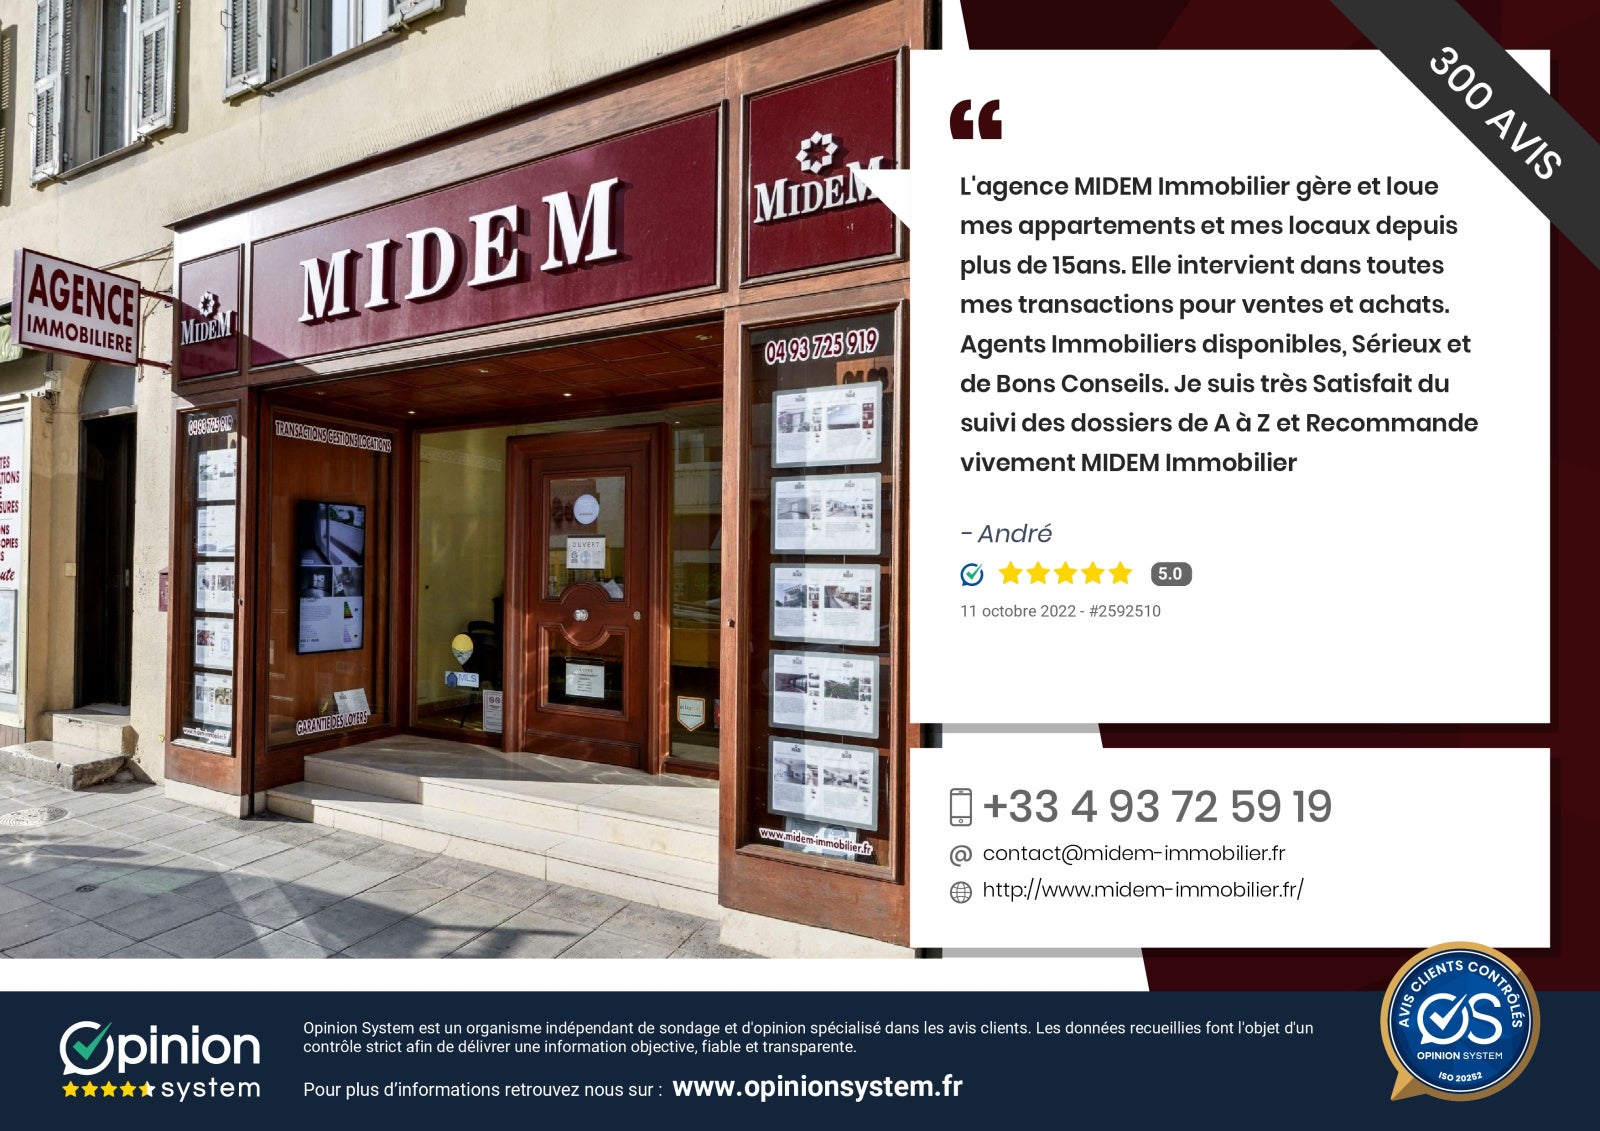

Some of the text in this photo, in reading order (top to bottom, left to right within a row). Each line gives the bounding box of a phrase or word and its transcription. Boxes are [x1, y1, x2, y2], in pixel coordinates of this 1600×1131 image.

[298, 177, 619, 322] MIDEM
[28, 263, 134, 327] AGENCE
[27, 314, 132, 353] IMMOBILIERE
[181, 310, 232, 346] MIDEM
[765, 327, 879, 365] 04 93 725 919
[275, 419, 391, 453] TRANSACTIONS GESTIONS LOCATIONS
[296, 715, 331, 736] GARANTIE
[331, 714, 344, 729] DES
[759, 827, 873, 856] www.midem-immobilier.fr
